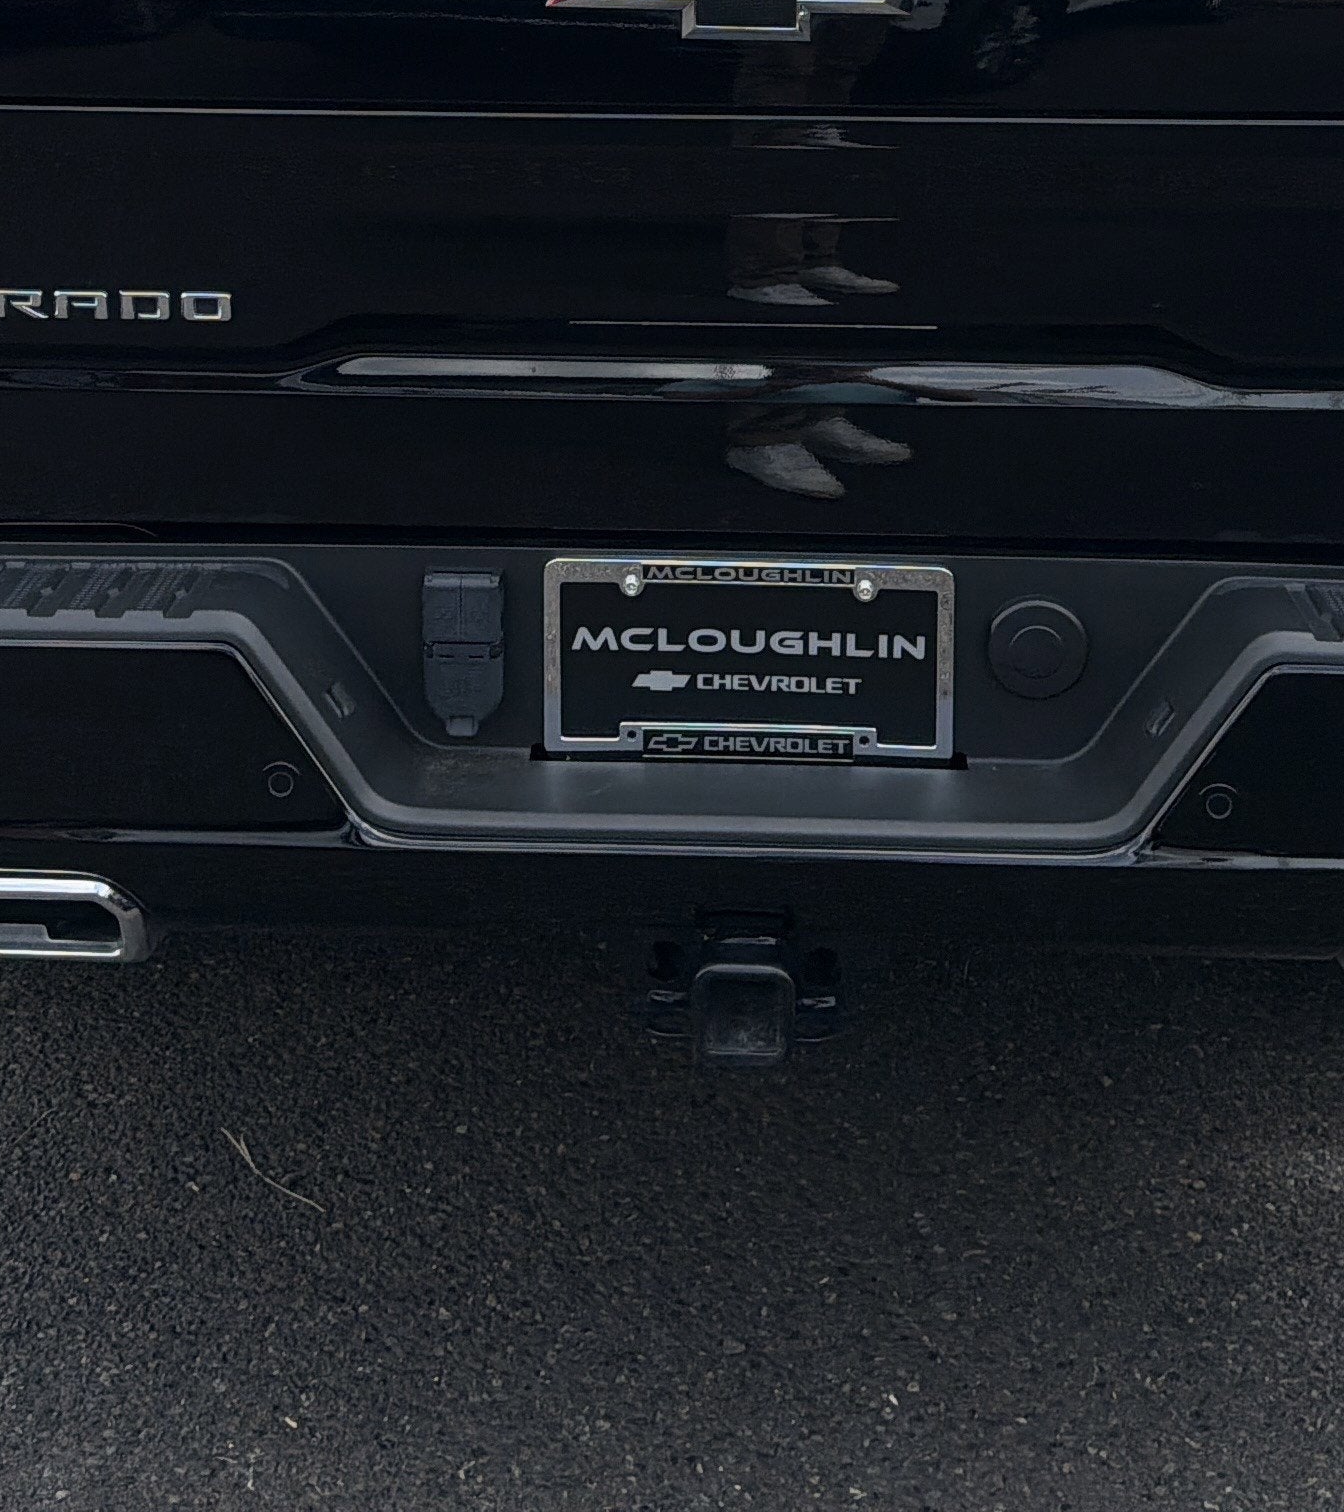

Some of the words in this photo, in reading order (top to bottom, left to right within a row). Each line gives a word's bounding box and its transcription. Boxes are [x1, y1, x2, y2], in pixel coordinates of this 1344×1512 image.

[646, 566, 853, 585] MCLOUGHLIN
[570, 625, 927, 661] MCLOUGHLIN
[696, 673, 863, 695] CHEVROLET
[703, 735, 851, 755] CHEVROLET
